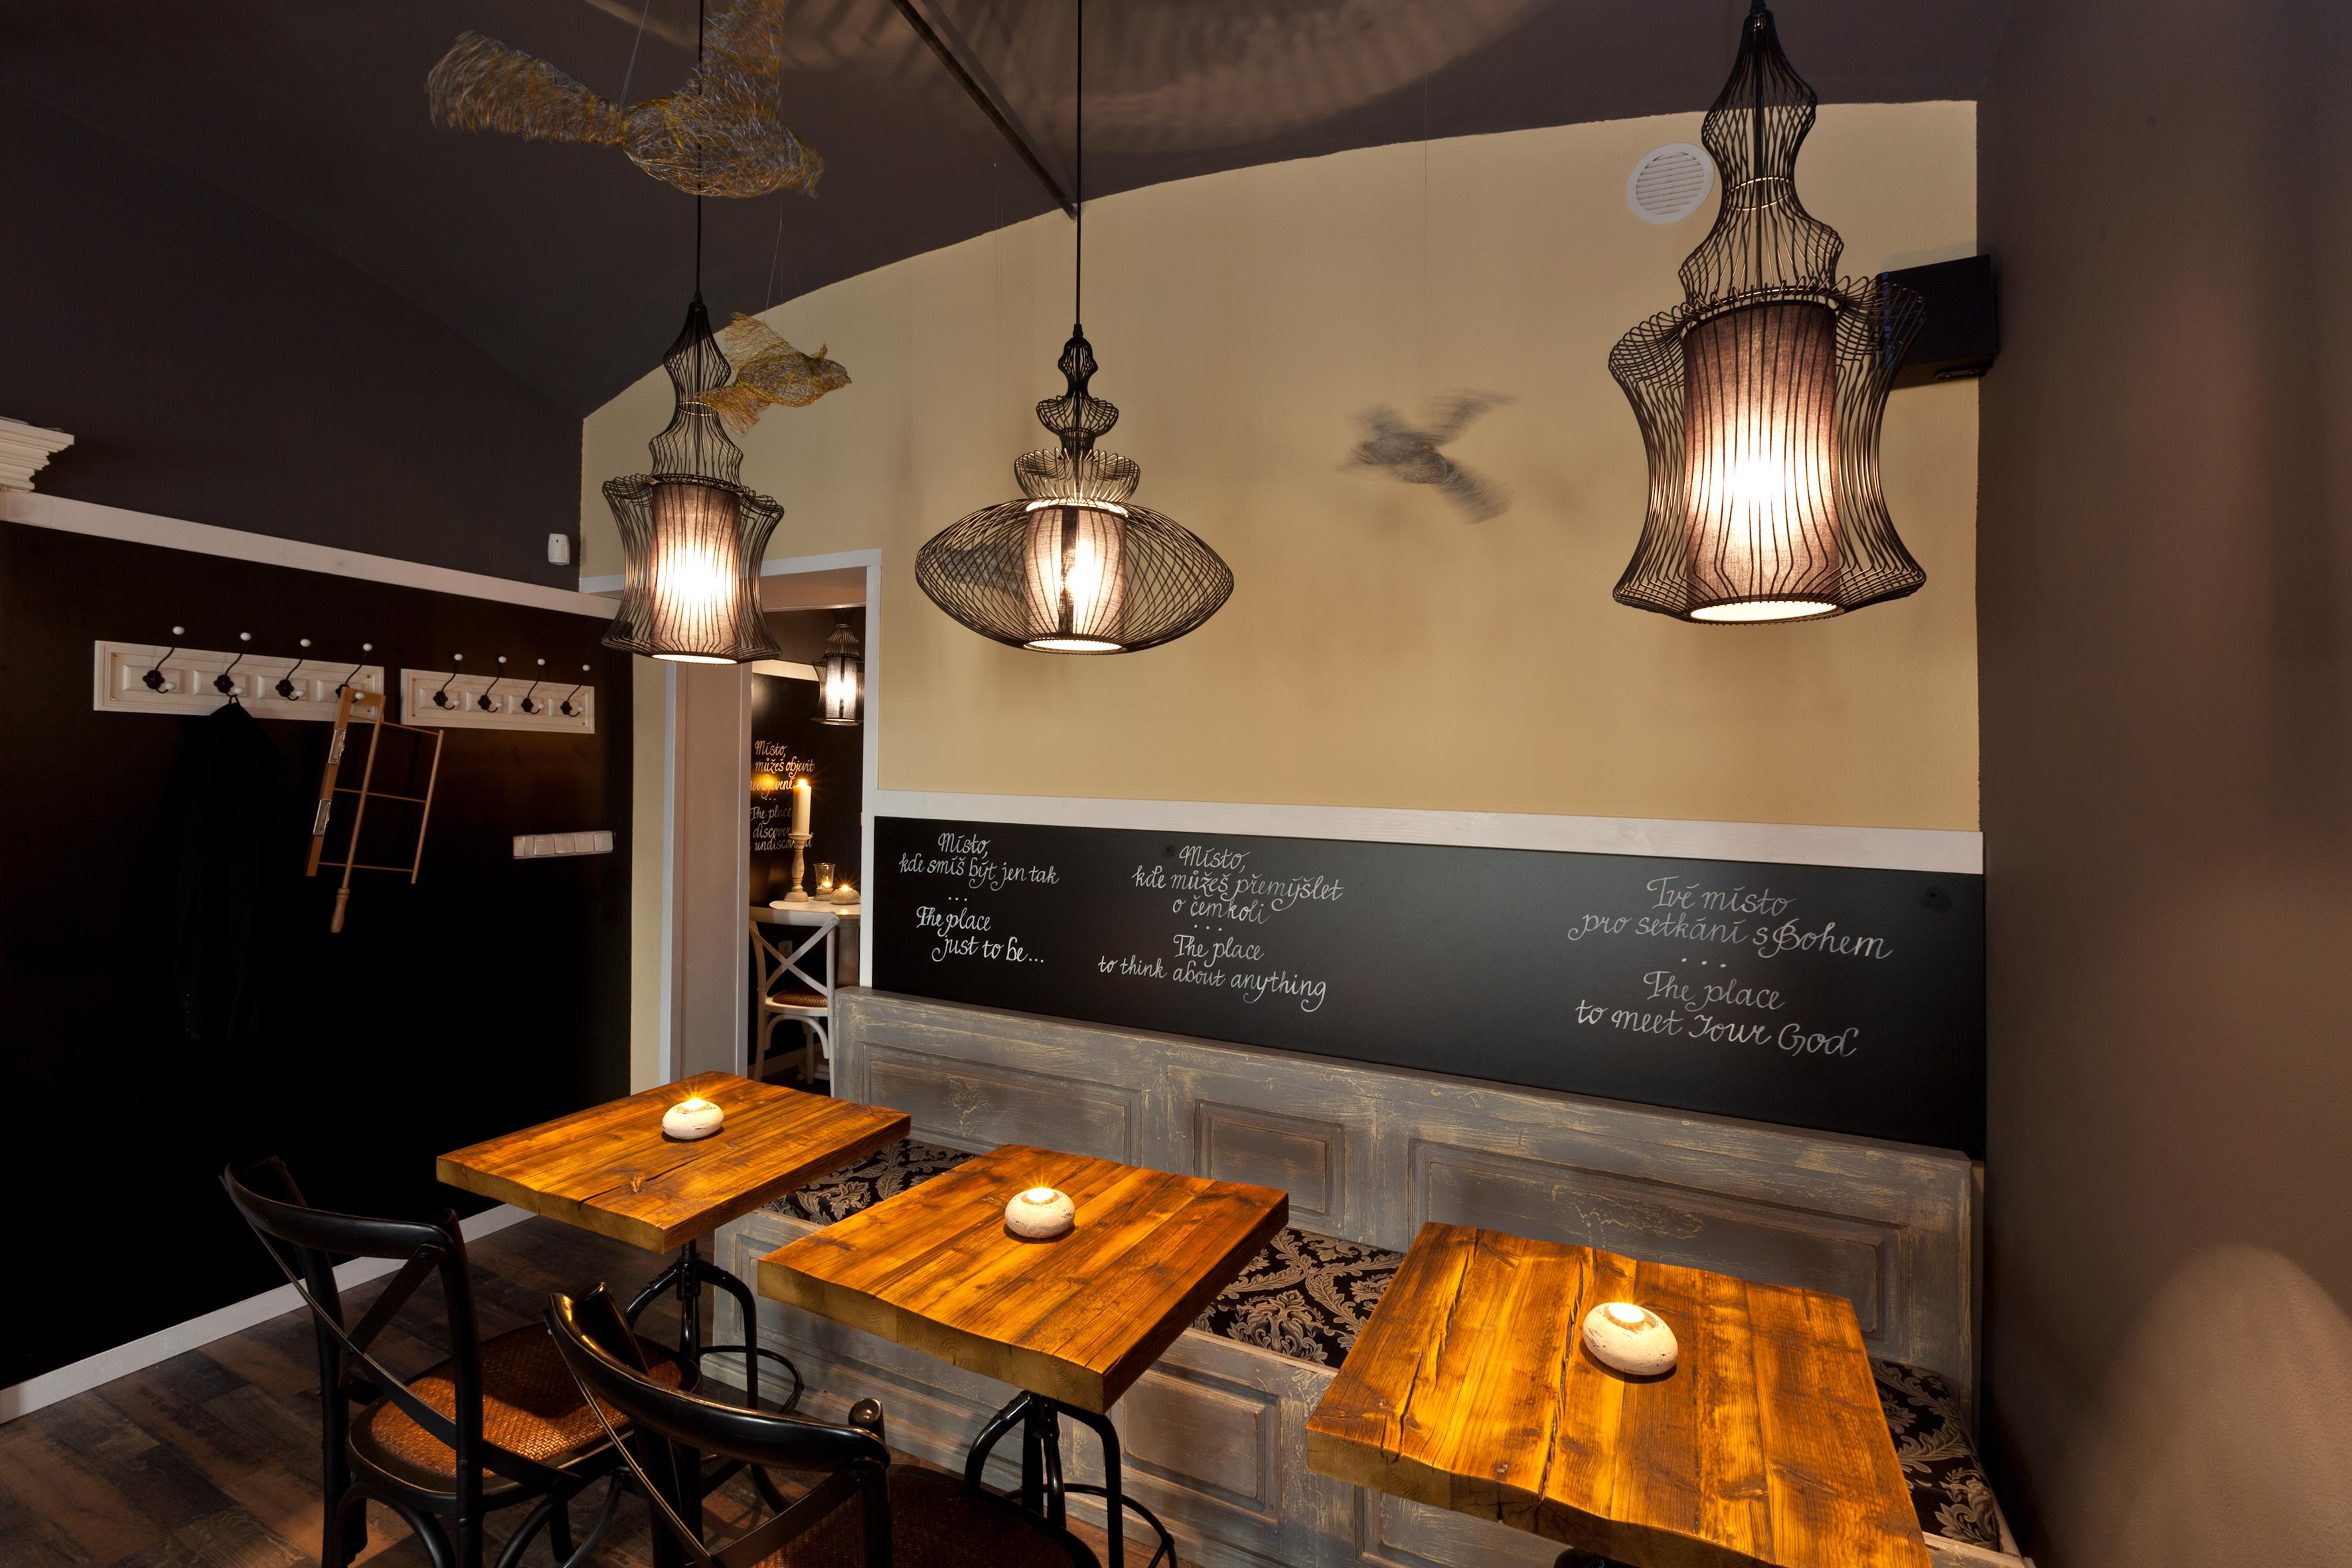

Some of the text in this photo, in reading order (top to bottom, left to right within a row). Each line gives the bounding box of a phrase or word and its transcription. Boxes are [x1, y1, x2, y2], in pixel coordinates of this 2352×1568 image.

[754, 740, 787, 758] Místo,
[754, 755, 815, 778] můžeš objevit
[749, 805, 793, 824] The place
[754, 832, 814, 852] undiscovd
[937, 832, 991, 860] Místo,
[898, 852, 1060, 892] kde smíš být jen tak
[1178, 844, 1251, 874] Místo,
[1131, 865, 1346, 912] kde můžeš přemýšlet
[1646, 876, 1797, 916] Tvé místo
[915, 905, 992, 937] The place
[1172, 898, 1187, 913] o
[931, 935, 980, 963] just
[981, 941, 1005, 959] to
[1172, 934, 1265, 969] The place
[1567, 913, 1632, 941] pro
[1634, 912, 1749, 944] setkání
[1758, 918, 1893, 960] Bohem
[1097, 954, 1328, 1013] to think about anything
[1643, 971, 1785, 1012] The place
[1575, 999, 1608, 1025] to
[1611, 1010, 1684, 1037] meet
[1778, 1023, 1859, 1058] God
